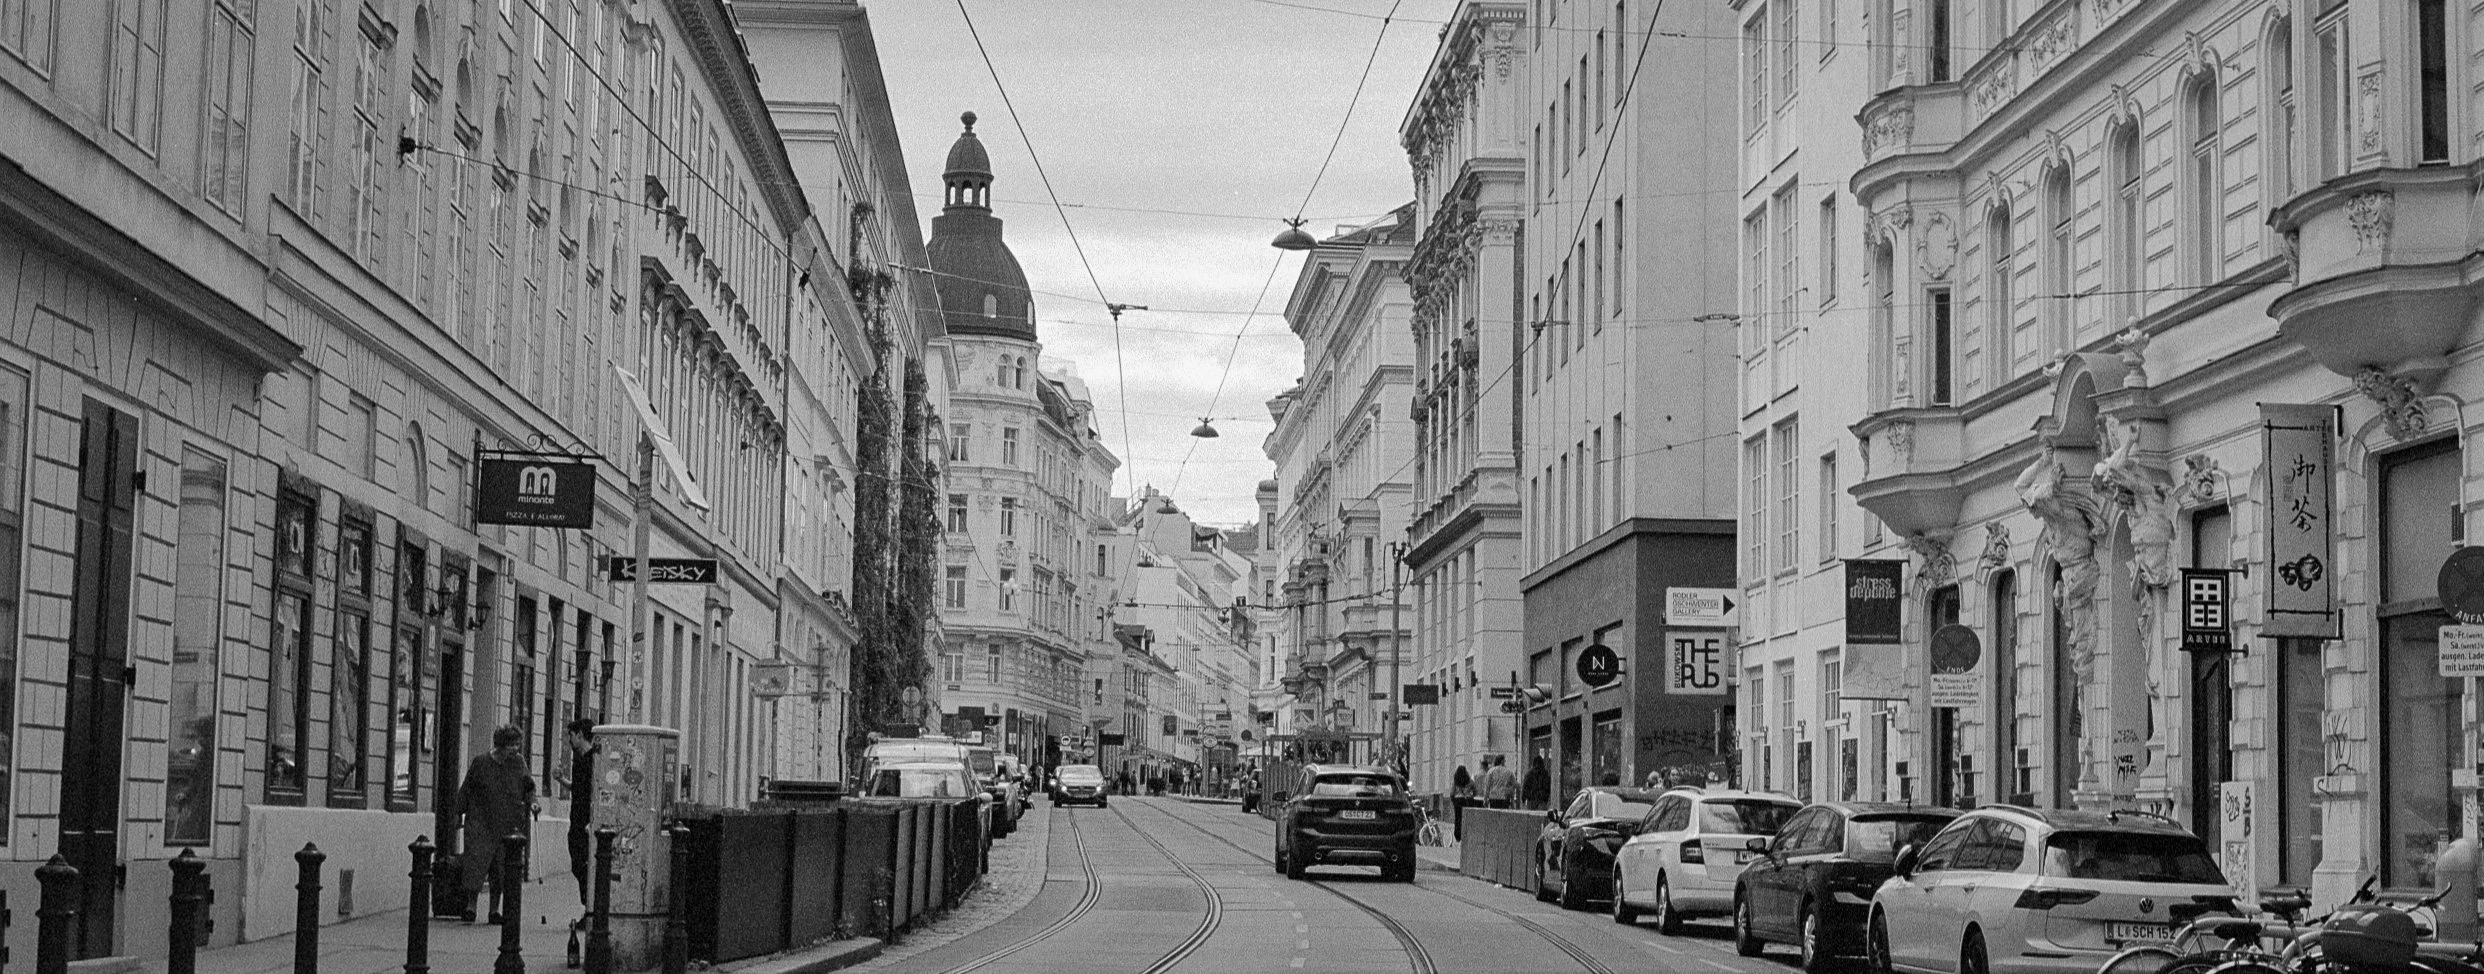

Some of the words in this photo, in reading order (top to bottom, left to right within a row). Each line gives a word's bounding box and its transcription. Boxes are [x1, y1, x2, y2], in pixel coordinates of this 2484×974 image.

[621, 559, 706, 581] KEISKY
[1855, 575, 1892, 589] stress
[2455, 610, 2484, 624] ANFA
[1675, 638, 1720, 664] THE
[2445, 663, 2457, 672] mit
[2132, 926, 2154, 939] SCH
